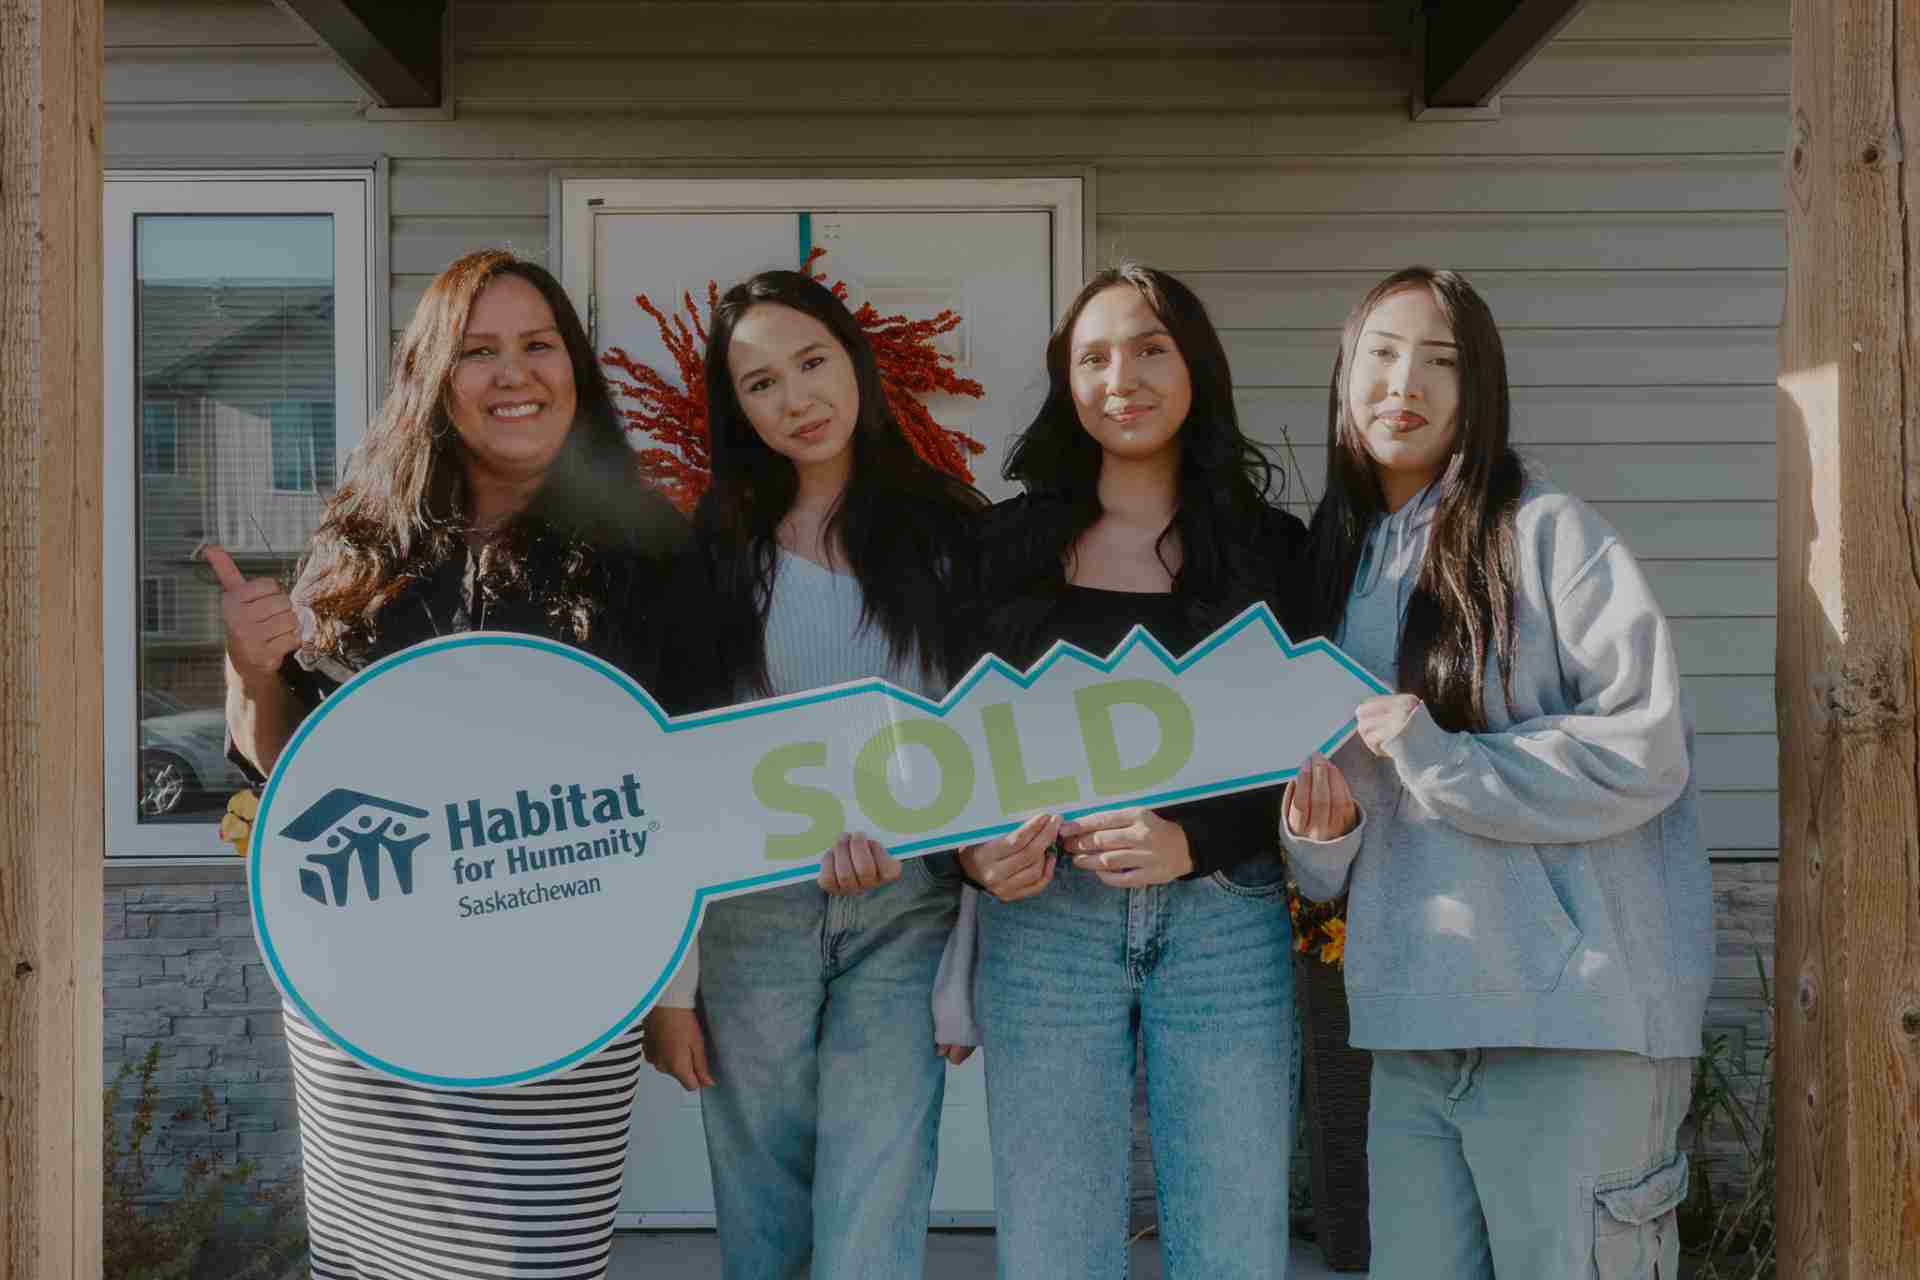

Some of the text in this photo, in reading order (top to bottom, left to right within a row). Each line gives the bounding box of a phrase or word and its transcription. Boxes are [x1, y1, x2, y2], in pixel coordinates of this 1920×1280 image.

[752, 679, 1195, 860] SOLD
[445, 774, 645, 851] Habitat
[453, 828, 648, 884] for Humanity
[458, 876, 602, 918] Saskatchewan
